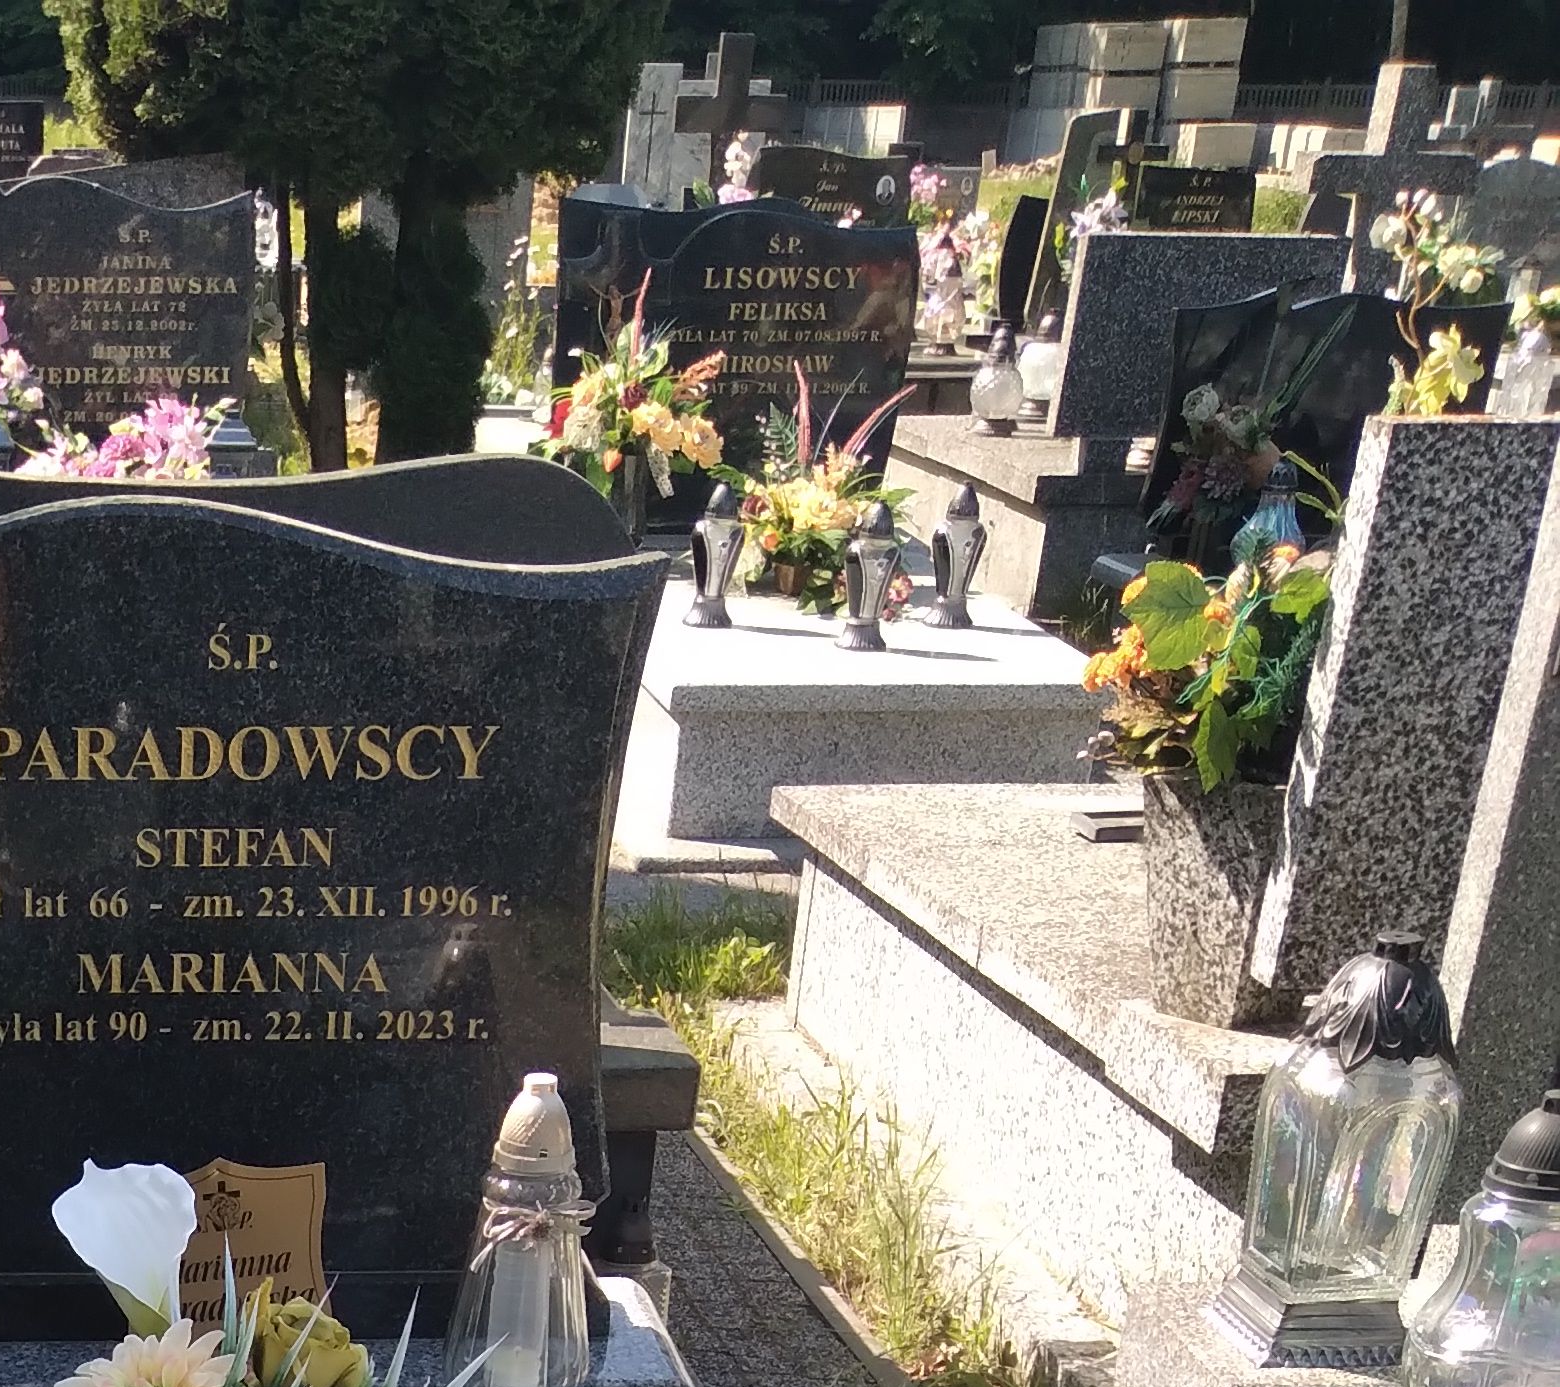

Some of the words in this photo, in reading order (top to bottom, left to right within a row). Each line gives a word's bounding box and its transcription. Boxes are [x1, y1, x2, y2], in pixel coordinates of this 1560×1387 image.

[99, 255, 172, 270] JANINA
[703, 266, 862, 290] LISOWSCY
[131, 300, 160, 312] LAT
[727, 302, 827, 321] FELIKSA
[709, 329, 736, 342] LAT
[743, 330, 759, 342] 70
[92, 345, 172, 359] HENRYK
[207, 623, 278, 671] Ś.P.
[134, 827, 338, 869] STEFAN
[24, 889, 68, 918] lat
[89, 887, 129, 918] 66
[183, 892, 243, 918] zm.
[256, 887, 305, 918] 23.
[317, 887, 385, 918] XII.
[400, 885, 478, 918] 1996
[488, 893, 512, 918] r.
[76, 952, 389, 994] MARIANNA
[55, 1011, 96, 1041] lat
[109, 1011, 148, 1041] 90
[193, 1018, 252, 1041] zm.
[264, 1011, 312, 1041] 22.
[325, 1012, 364, 1041] II.
[377, 1010, 455, 1041] 2023
[467, 1018, 489, 1041] r.
